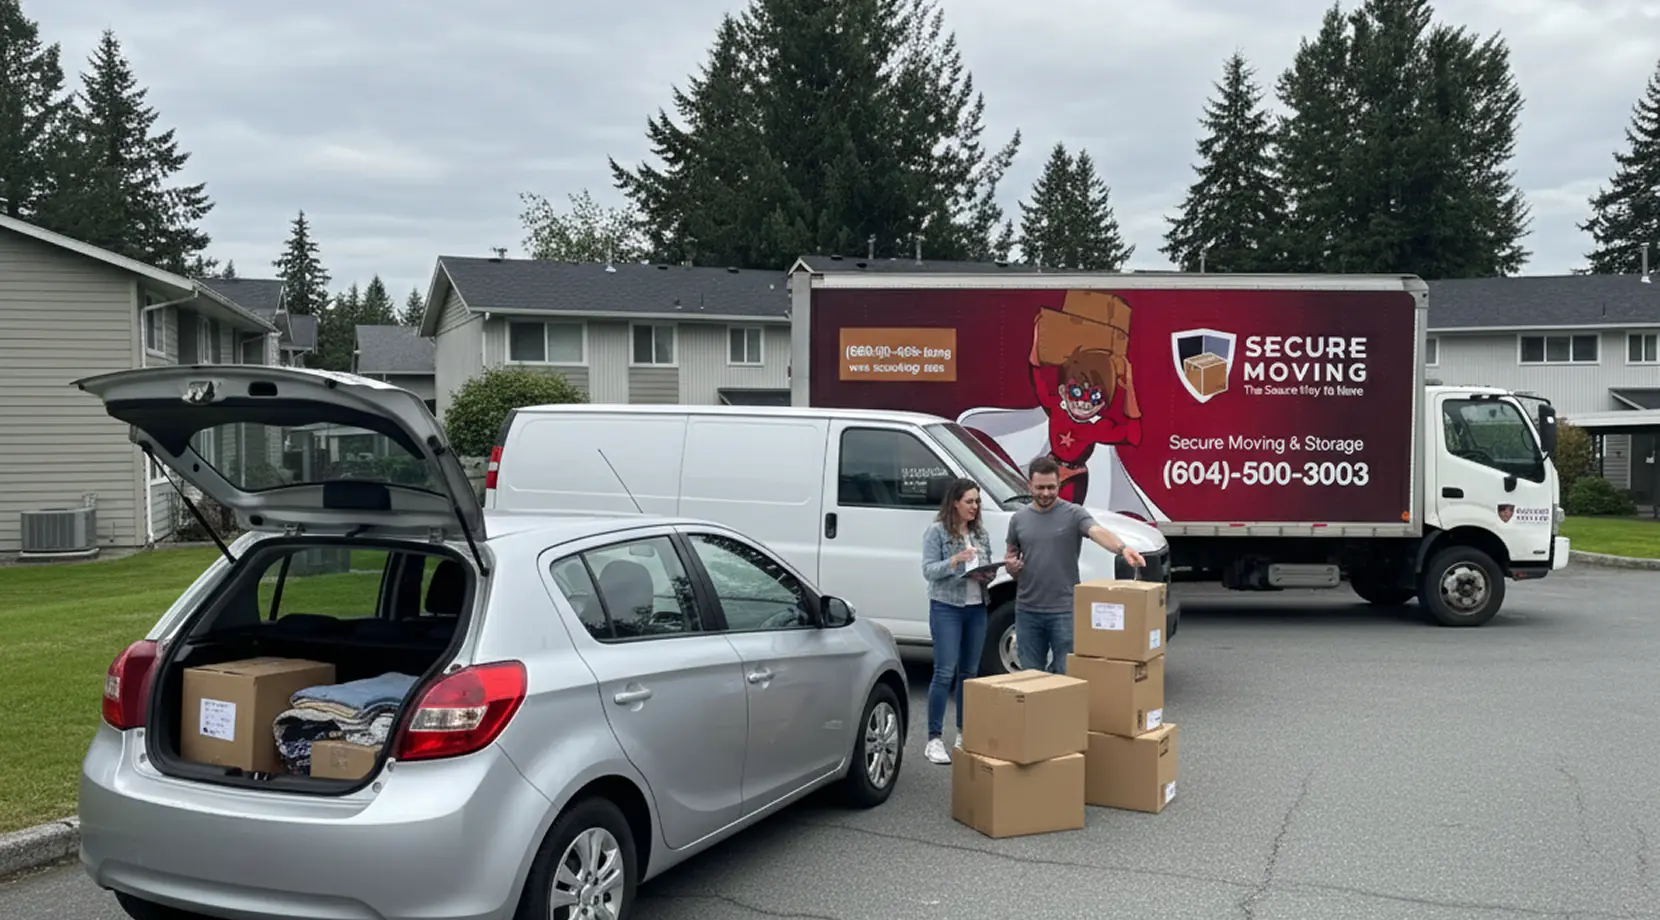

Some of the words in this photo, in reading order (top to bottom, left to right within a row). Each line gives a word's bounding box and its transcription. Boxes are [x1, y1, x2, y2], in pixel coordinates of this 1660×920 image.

[1245, 335, 1368, 359] SECURE
[1243, 361, 1367, 383] MOVING
[1169, 435, 1225, 450] Secure
[1228, 435, 1286, 455] Moving
[1289, 435, 1302, 451] &
[1305, 435, 1364, 455] Storage
[1163, 459, 1370, 490] (604)-500-3003
